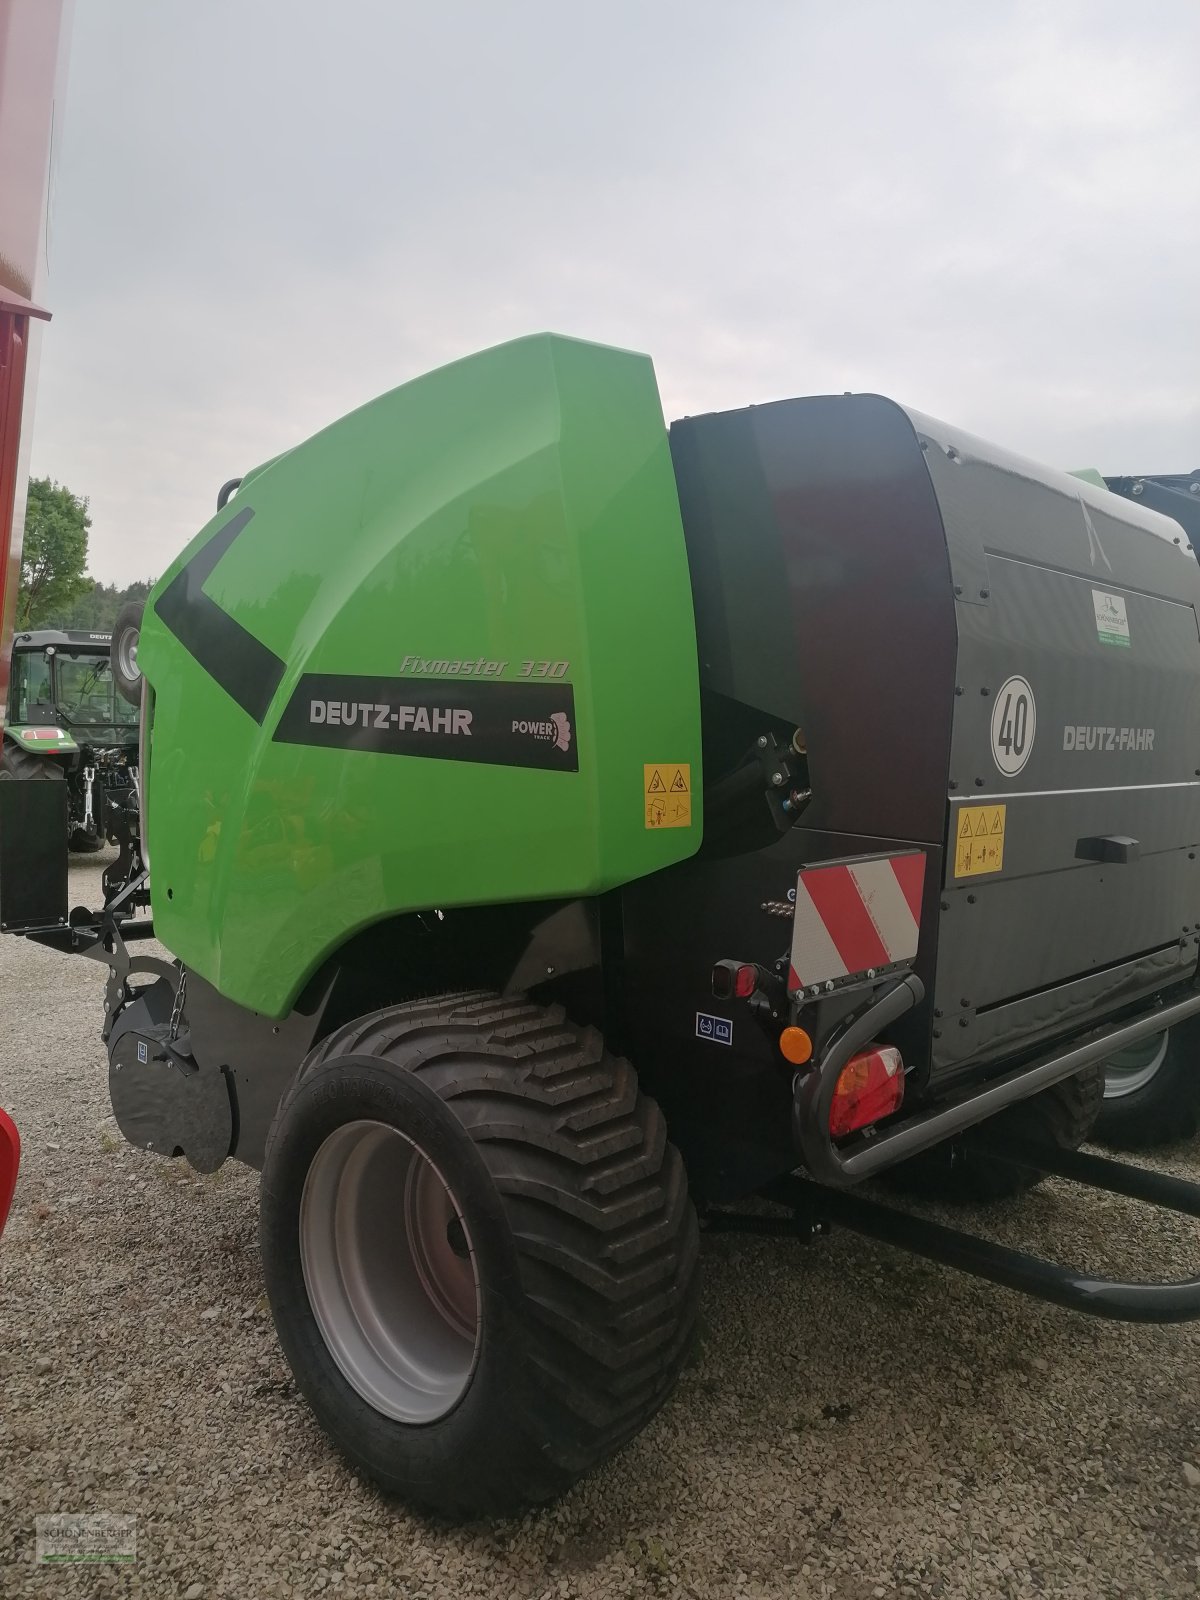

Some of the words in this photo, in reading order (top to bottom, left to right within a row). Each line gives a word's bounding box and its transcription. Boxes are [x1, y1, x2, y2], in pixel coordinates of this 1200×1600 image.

[400, 655, 509, 677] Fixmaster
[517, 660, 570, 678] 330
[309, 700, 473, 736] DEUTZ-FAHR
[511, 720, 553, 736] POWER
[998, 693, 1029, 756] 40
[1062, 725, 1155, 751] DEUTZ-FAHR
